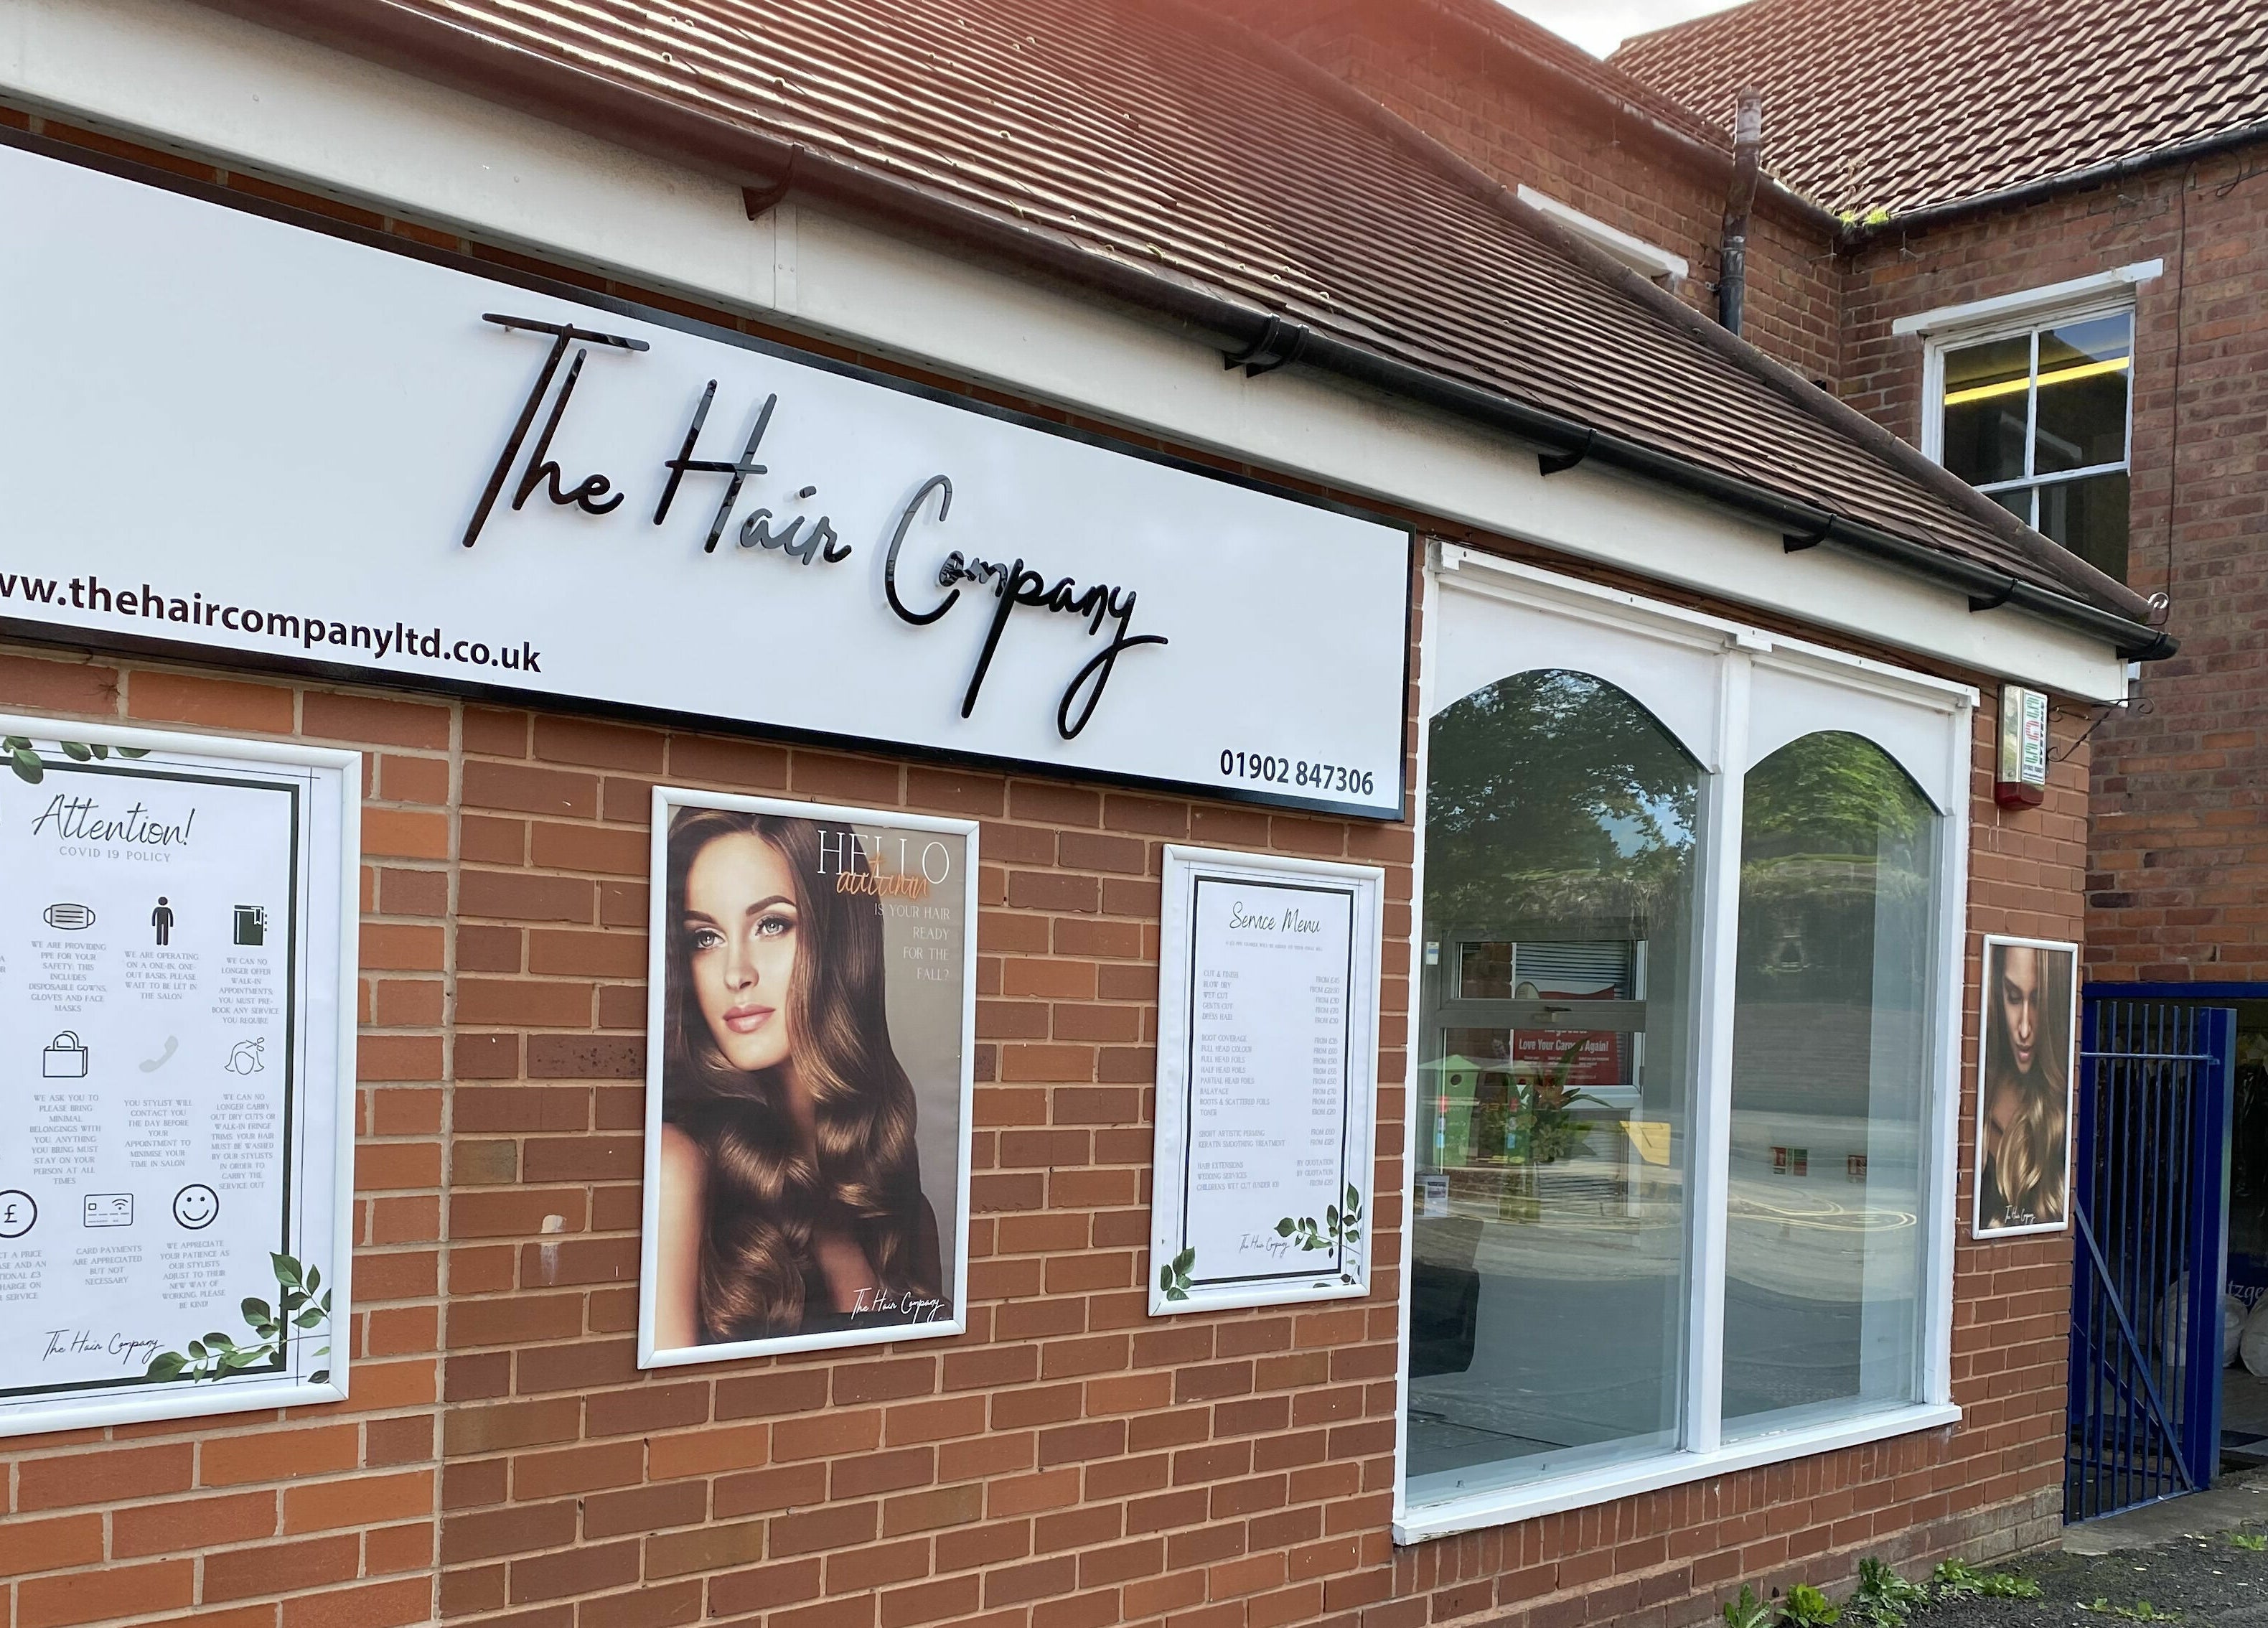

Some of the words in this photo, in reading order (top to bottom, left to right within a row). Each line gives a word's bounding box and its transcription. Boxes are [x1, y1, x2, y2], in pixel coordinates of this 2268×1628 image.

[462, 312, 650, 547] The
[653, 379, 851, 553] Hair
[885, 474, 1168, 740] Company
[1220, 749, 1289, 783] 01902
[1295, 761, 1374, 795] 847306
[32, 794, 195, 845] Attention!
[60, 846, 100, 858] COVID
[108, 850, 119, 859] 19
[127, 851, 171, 862] POLICY
[817, 830, 950, 884] HELLO
[837, 851, 928, 899] autumn
[874, 903, 884, 915] IS
[889, 904, 919, 917] YOUR
[924, 907, 950, 920] HAIR
[1229, 902, 1276, 930] Service
[1281, 908, 1320, 933] Menu
[913, 927, 949, 940] READY
[65, 942, 106, 950] PROVIDING
[903, 946, 923, 959] FOR
[928, 948, 949, 960] THE
[156, 952, 199, 960] OPERATING
[50, 973, 87, 981] INCLUDES
[917, 968, 949, 981] FALL?
[1519, 1039, 1535, 1050] Love
[1538, 1039, 1553, 1050] Your
[1585, 1040, 1608, 1053] Again!
[90, 1255, 142, 1265] APPRECIATED
[85, 1276, 128, 1286] NECESSARY
[851, 1288, 872, 1319] The
[871, 1289, 897, 1312] Hair
[901, 1291, 945, 1324] Company
[43, 1329, 70, 1361] The
[71, 1330, 102, 1353] Hair
[108, 1333, 164, 1364] Company
